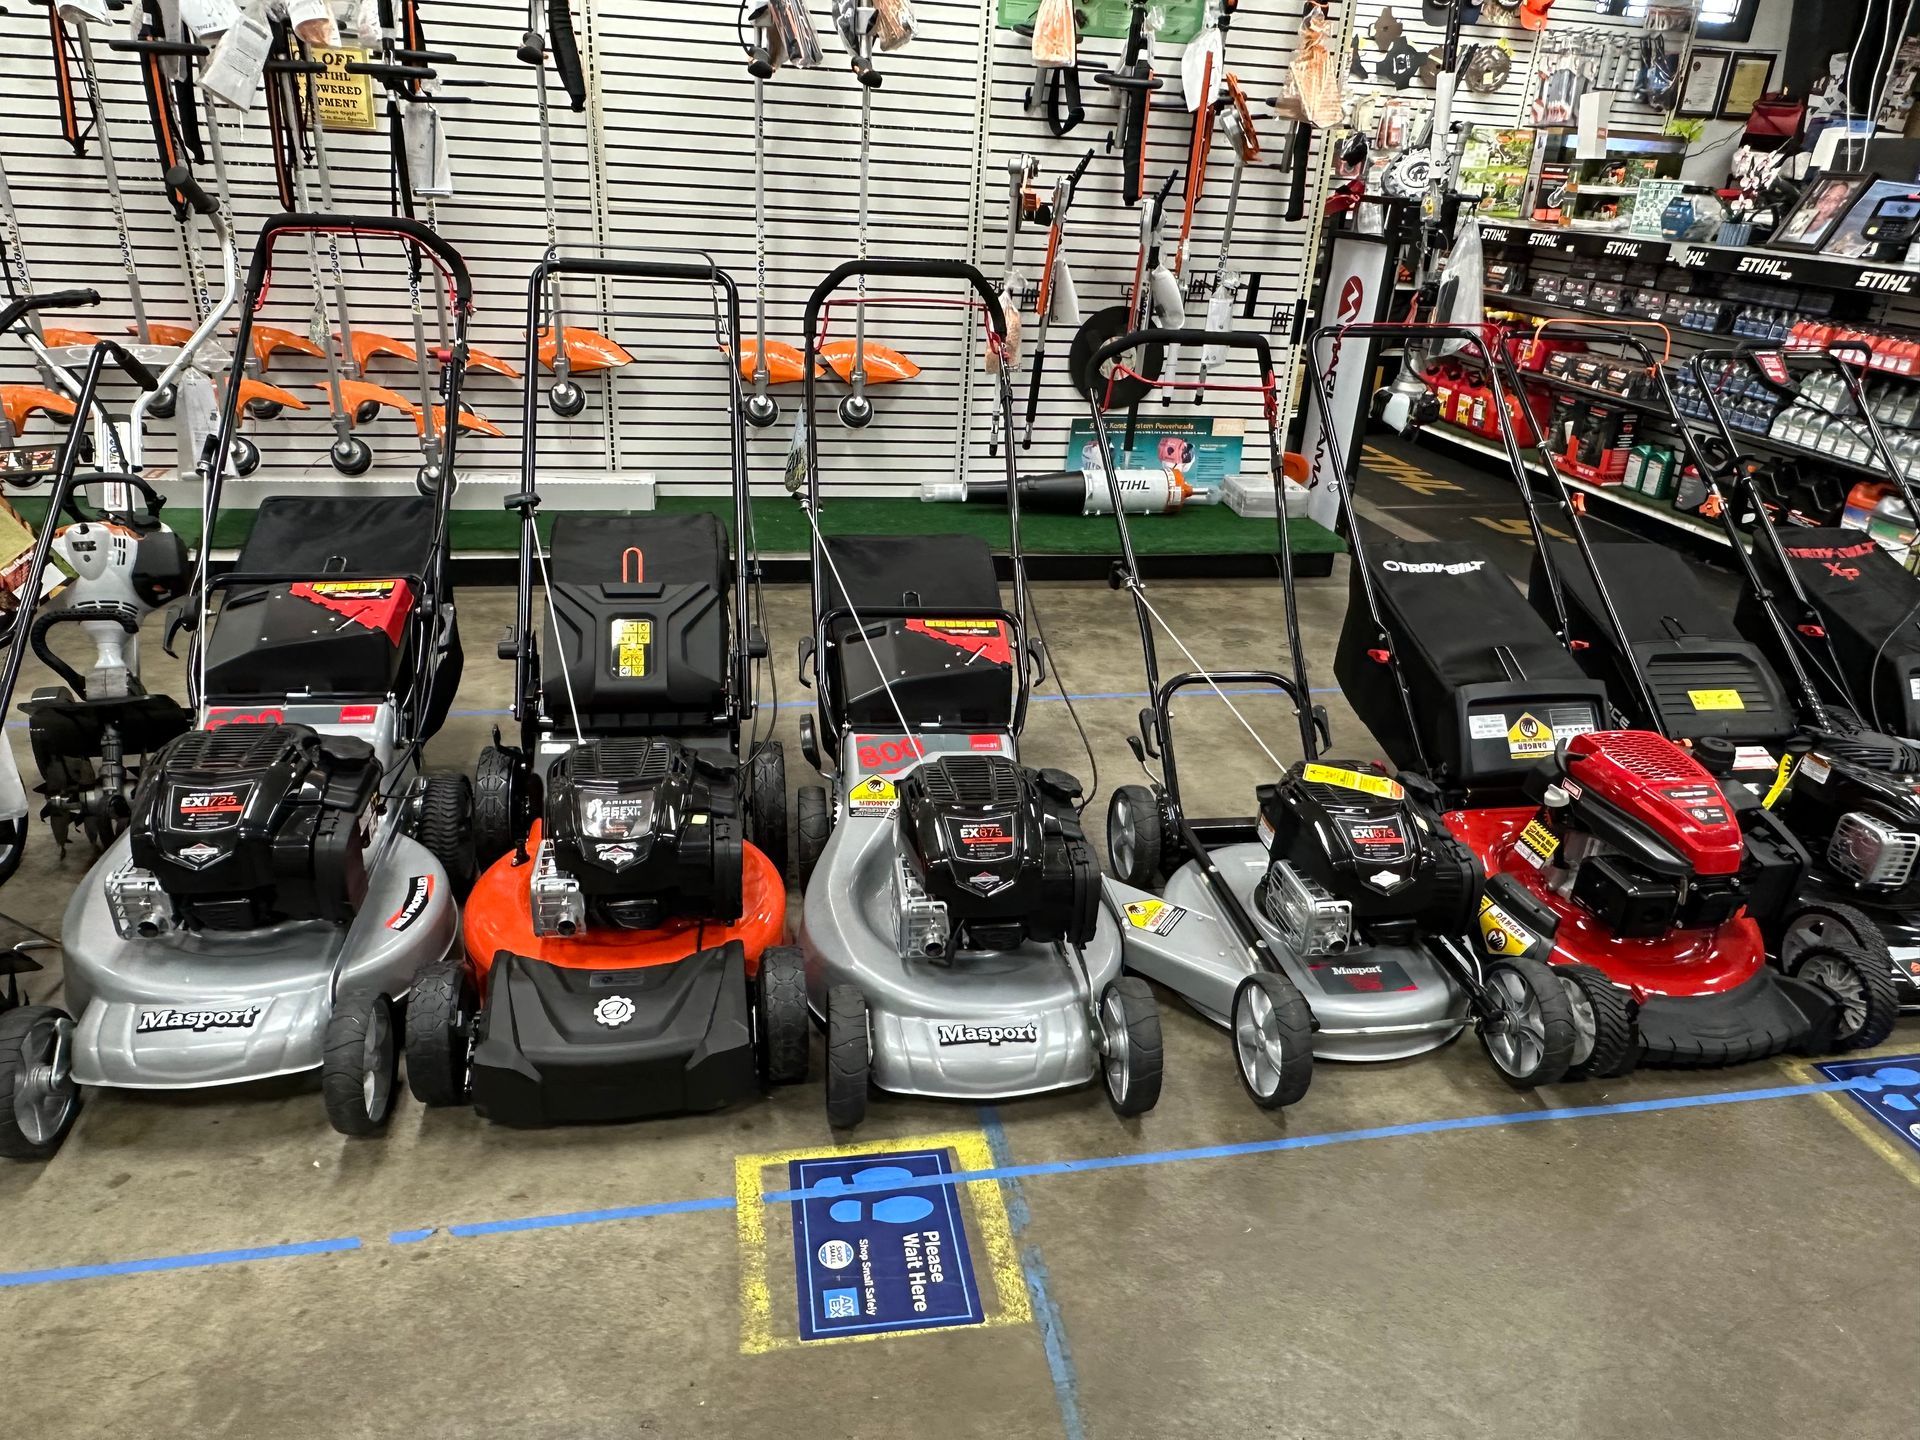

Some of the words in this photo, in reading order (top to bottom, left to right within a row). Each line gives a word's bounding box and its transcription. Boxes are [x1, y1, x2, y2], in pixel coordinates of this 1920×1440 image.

[322, 52, 355, 66] OFF
[315, 72, 351, 82] STIHL
[1481, 228, 1508, 242] STIHL
[1527, 232, 1558, 248] STIHL
[1603, 241, 1639, 257] STIHL
[1736, 256, 1783, 276] STIHL
[1855, 271, 1912, 293] STIHL
[1118, 480, 1151, 490] TIHL
[137, 1006, 259, 1033] Masport
[938, 1022, 1037, 1046] Masport
[859, 1238, 869, 1261] Shop
[903, 1232, 923, 1269] Wait
[923, 1230, 944, 1283] Please
[862, 1262, 874, 1287] Small
[865, 1287, 878, 1316] Safely
[909, 1272, 928, 1312] Here
